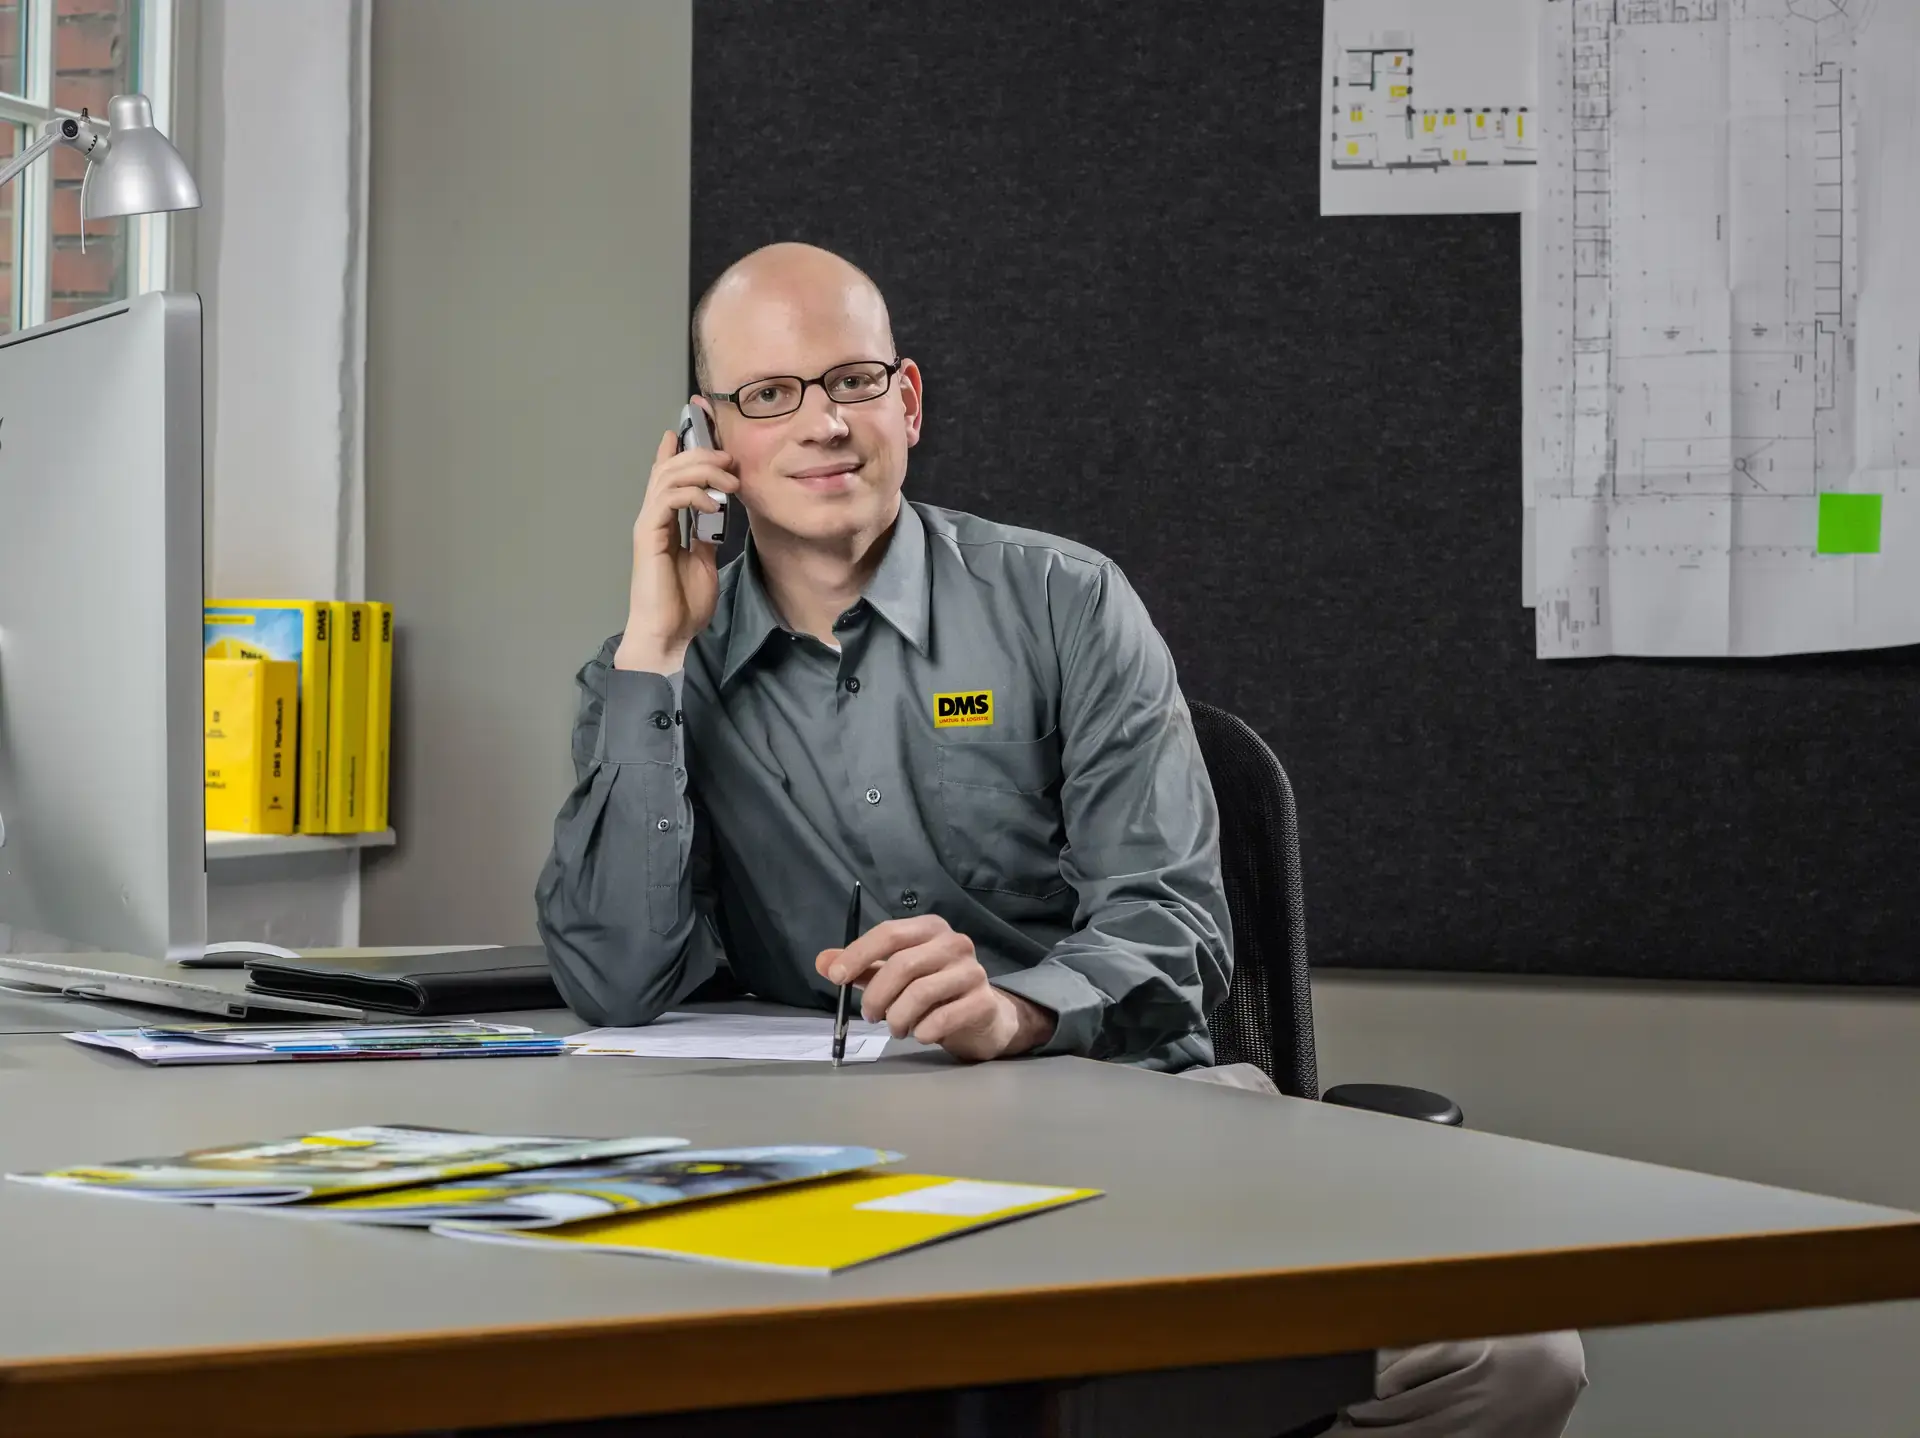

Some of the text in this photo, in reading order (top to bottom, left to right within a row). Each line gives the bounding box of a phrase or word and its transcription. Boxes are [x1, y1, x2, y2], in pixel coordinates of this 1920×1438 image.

[316, 609, 326, 640] DMS
[352, 610, 361, 642] DMS
[382, 611, 391, 642] DMS
[938, 694, 989, 717] DMS
